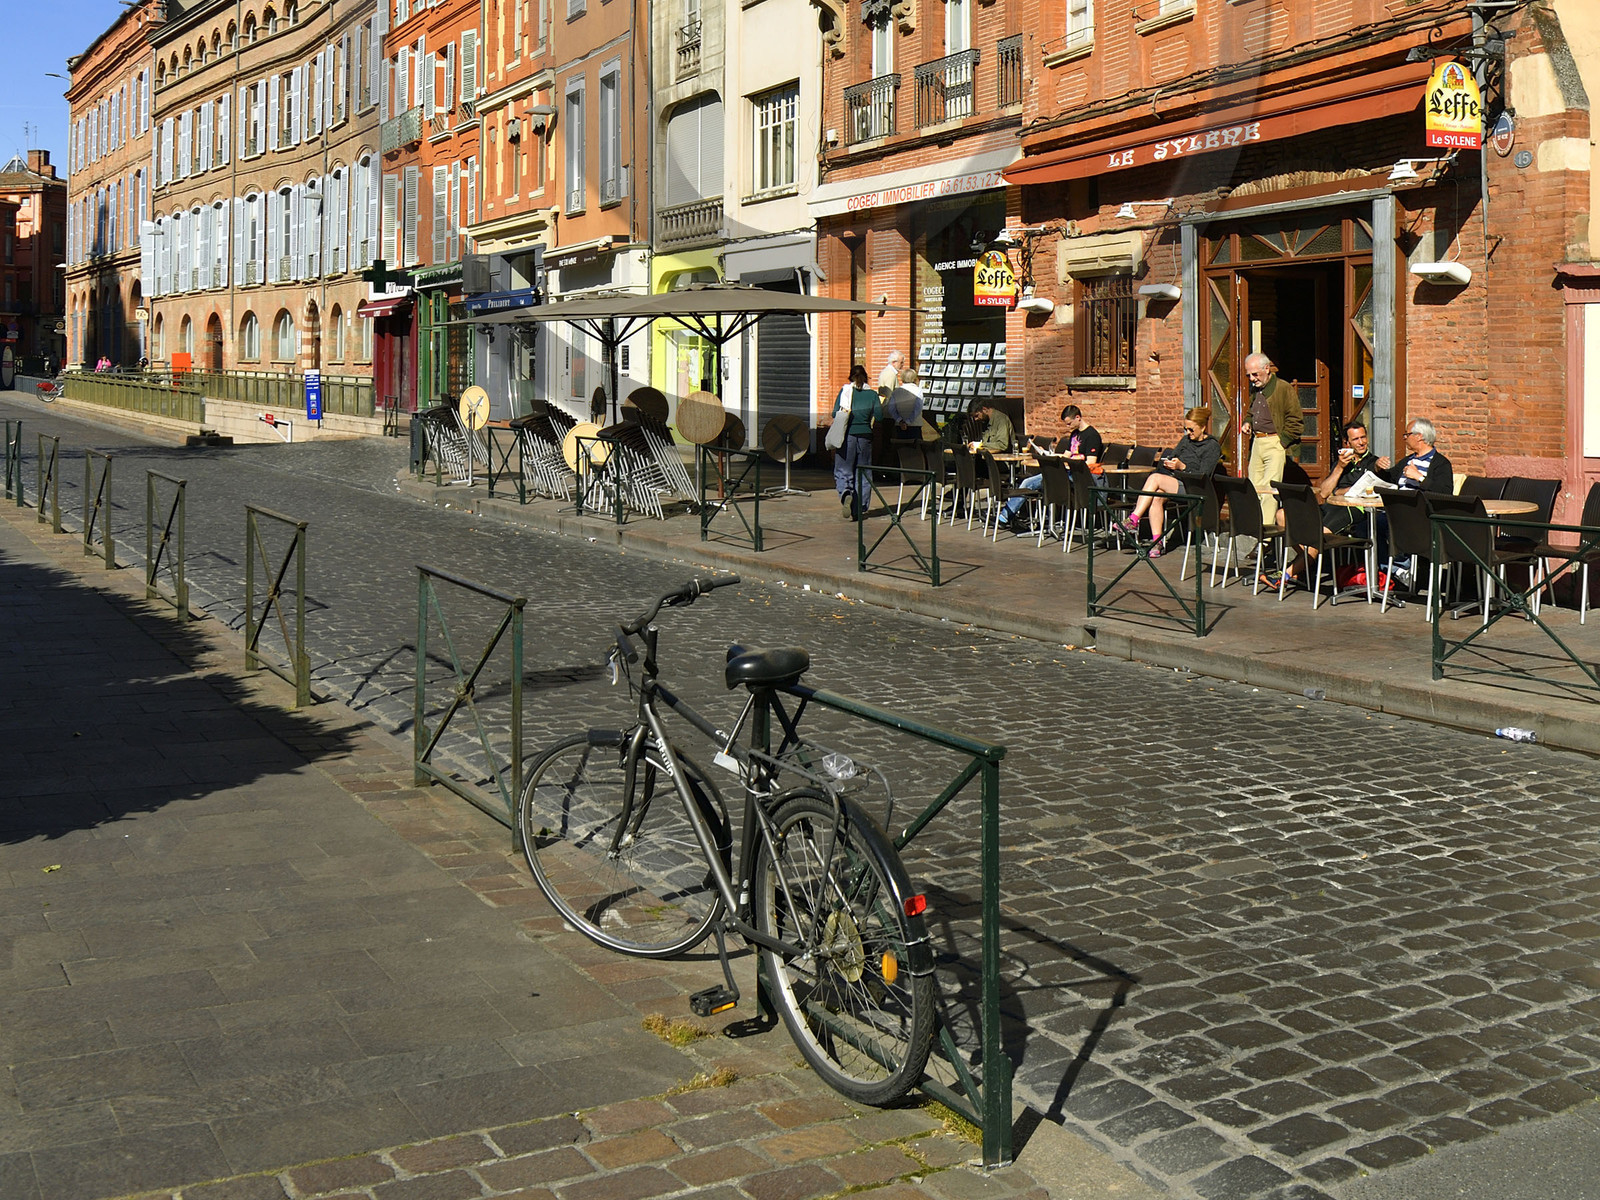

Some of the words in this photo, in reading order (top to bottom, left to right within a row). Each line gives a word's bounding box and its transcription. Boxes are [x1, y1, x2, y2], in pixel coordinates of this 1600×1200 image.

[1428, 88, 1479, 121] Leffe
[1432, 134, 1443, 145] Le
[1444, 135, 1477, 147] SYLENE
[1107, 149, 1135, 168] LE
[847, 193, 879, 210] COGECI
[882, 183, 935, 205] IMMOBILIER
[934, 261, 956, 271] AGENCE
[976, 268, 1013, 289] Leffe
[978, 297, 986, 305] Le
[987, 297, 1011, 305] SYLENE
